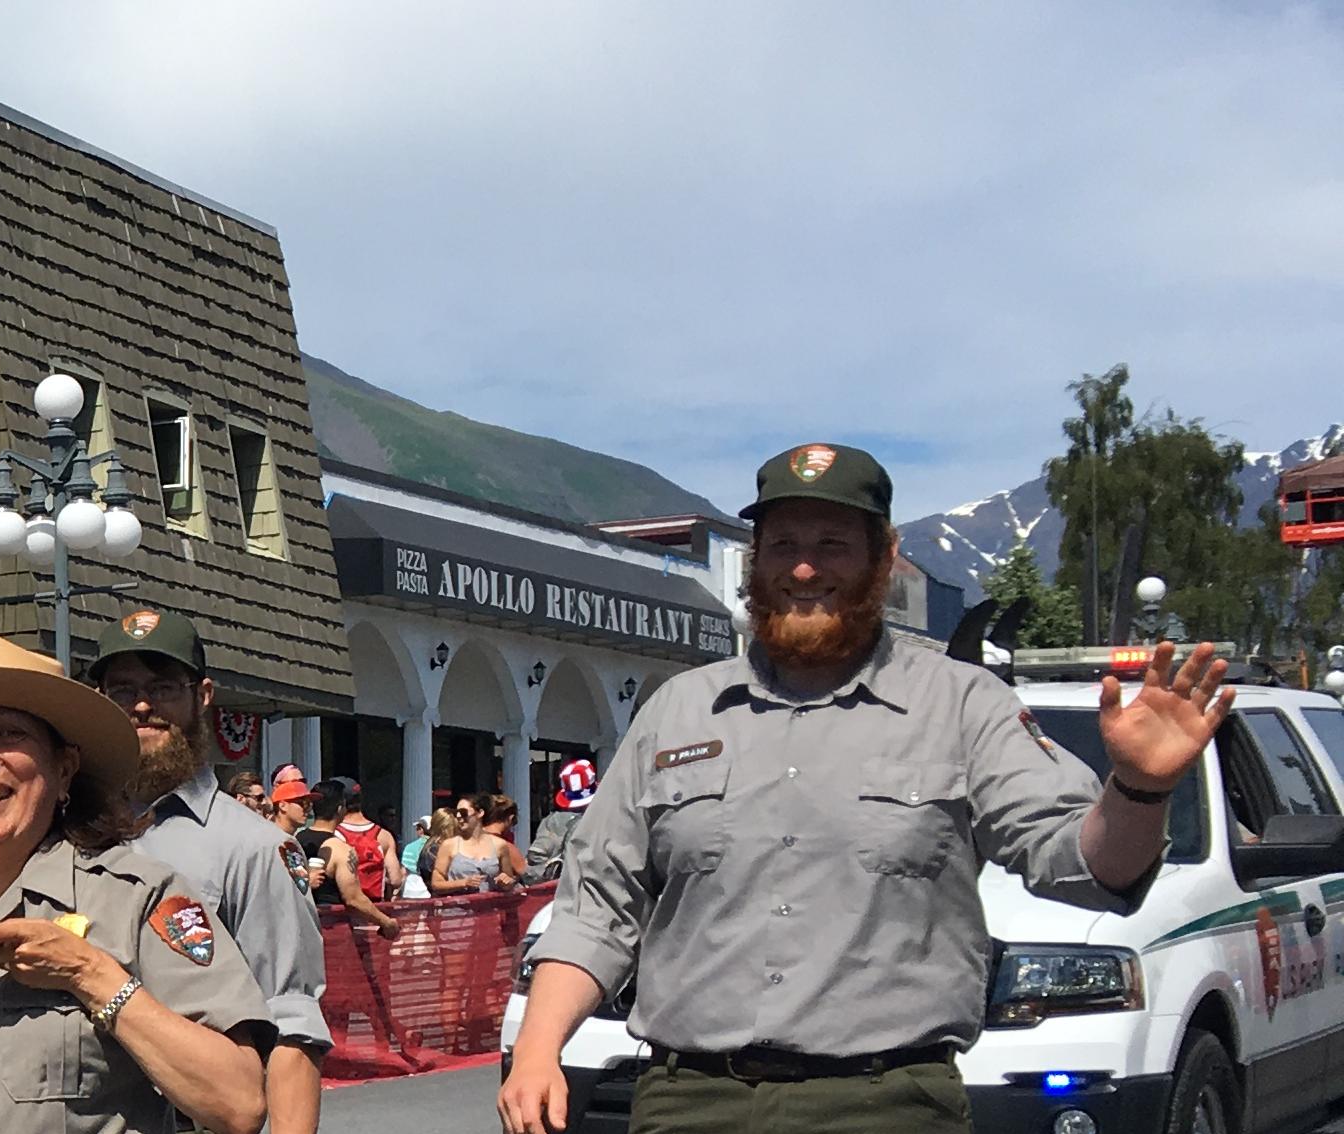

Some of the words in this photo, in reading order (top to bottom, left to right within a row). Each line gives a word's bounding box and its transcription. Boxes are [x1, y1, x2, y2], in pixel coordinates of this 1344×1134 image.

[397, 548, 428, 574] PIZZA
[396, 570, 429, 595] PASTA
[438, 560, 536, 615] APOLLO
[545, 582, 695, 646] RESTAURANT
[700, 614, 730, 637] STEAKS
[698, 632, 732, 655] SEAFOOD
